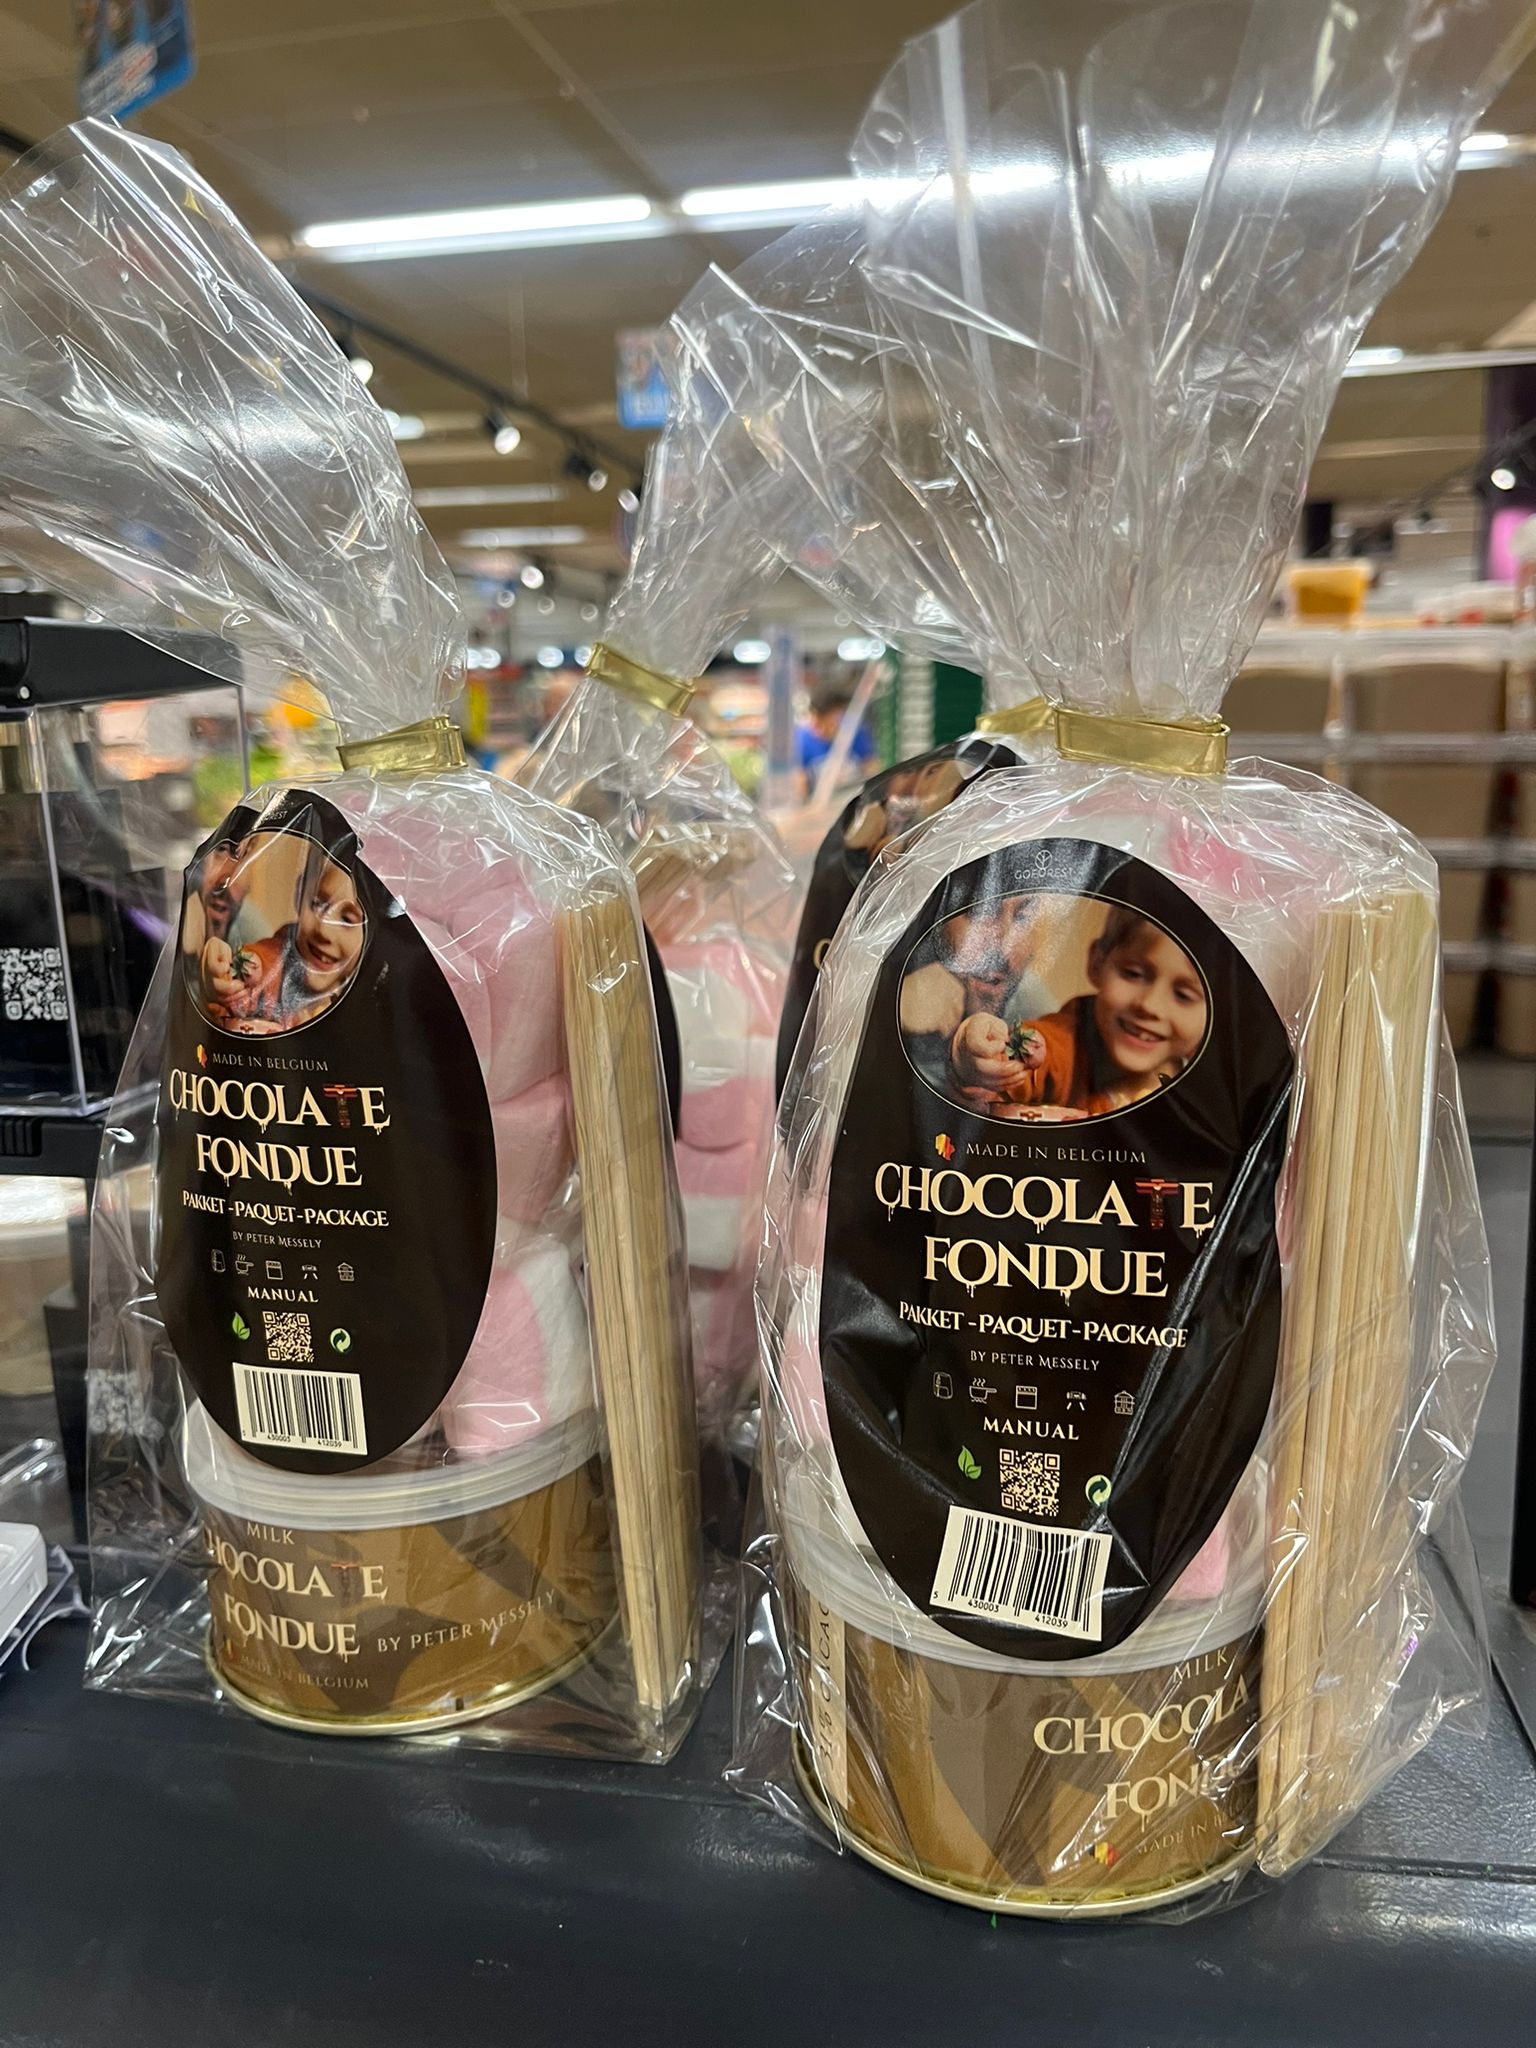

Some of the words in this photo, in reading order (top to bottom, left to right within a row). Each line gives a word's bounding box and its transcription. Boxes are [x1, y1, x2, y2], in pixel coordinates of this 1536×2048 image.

[1014, 867, 1073, 880] GOFOREST
[213, 1053, 244, 1066] MADE
[248, 1056, 262, 1067] IN
[266, 1057, 329, 1072] BELGIUM
[170, 1068, 391, 1136] CHOCOLATE
[196, 1133, 363, 1196] FONDUE
[965, 1142, 1020, 1160] MADE
[1027, 1146, 1049, 1160] IN
[1057, 1147, 1147, 1164] BELGIUM
[183, 1190, 226, 1215] PAKKET
[874, 1162, 1217, 1238] CHOCOLATE
[232, 1231, 244, 1242] BY
[246, 1233, 276, 1246] PETER
[278, 1235, 322, 1249] MESSELY
[923, 1234, 1169, 1306] FONDUE
[247, 1286, 319, 1303] MANUAL
[900, 1301, 965, 1331] PAKKET
[969, 1350, 986, 1363] BY
[991, 1352, 1034, 1367] PETER
[1038, 1354, 1101, 1372] MESSELY
[982, 1416, 1080, 1441] MANUAL
[246, 1521, 295, 1545] MILK
[206, 1527, 388, 1605] HOCOLATE
[224, 1592, 361, 1663] FONDUE
[377, 1636, 401, 1653] BY
[410, 1623, 473, 1649] PETER
[479, 1588, 555, 1634] MESSELY
[932, 1591, 939, 1600] 5
[967, 1599, 1000, 1614] 430003
[1034, 1615, 1069, 1629] 412039
[817, 1600, 832, 1703] CCA
[1172, 1646, 1228, 1684] MILK
[1033, 1673, 1249, 1756] CHOCOLA
